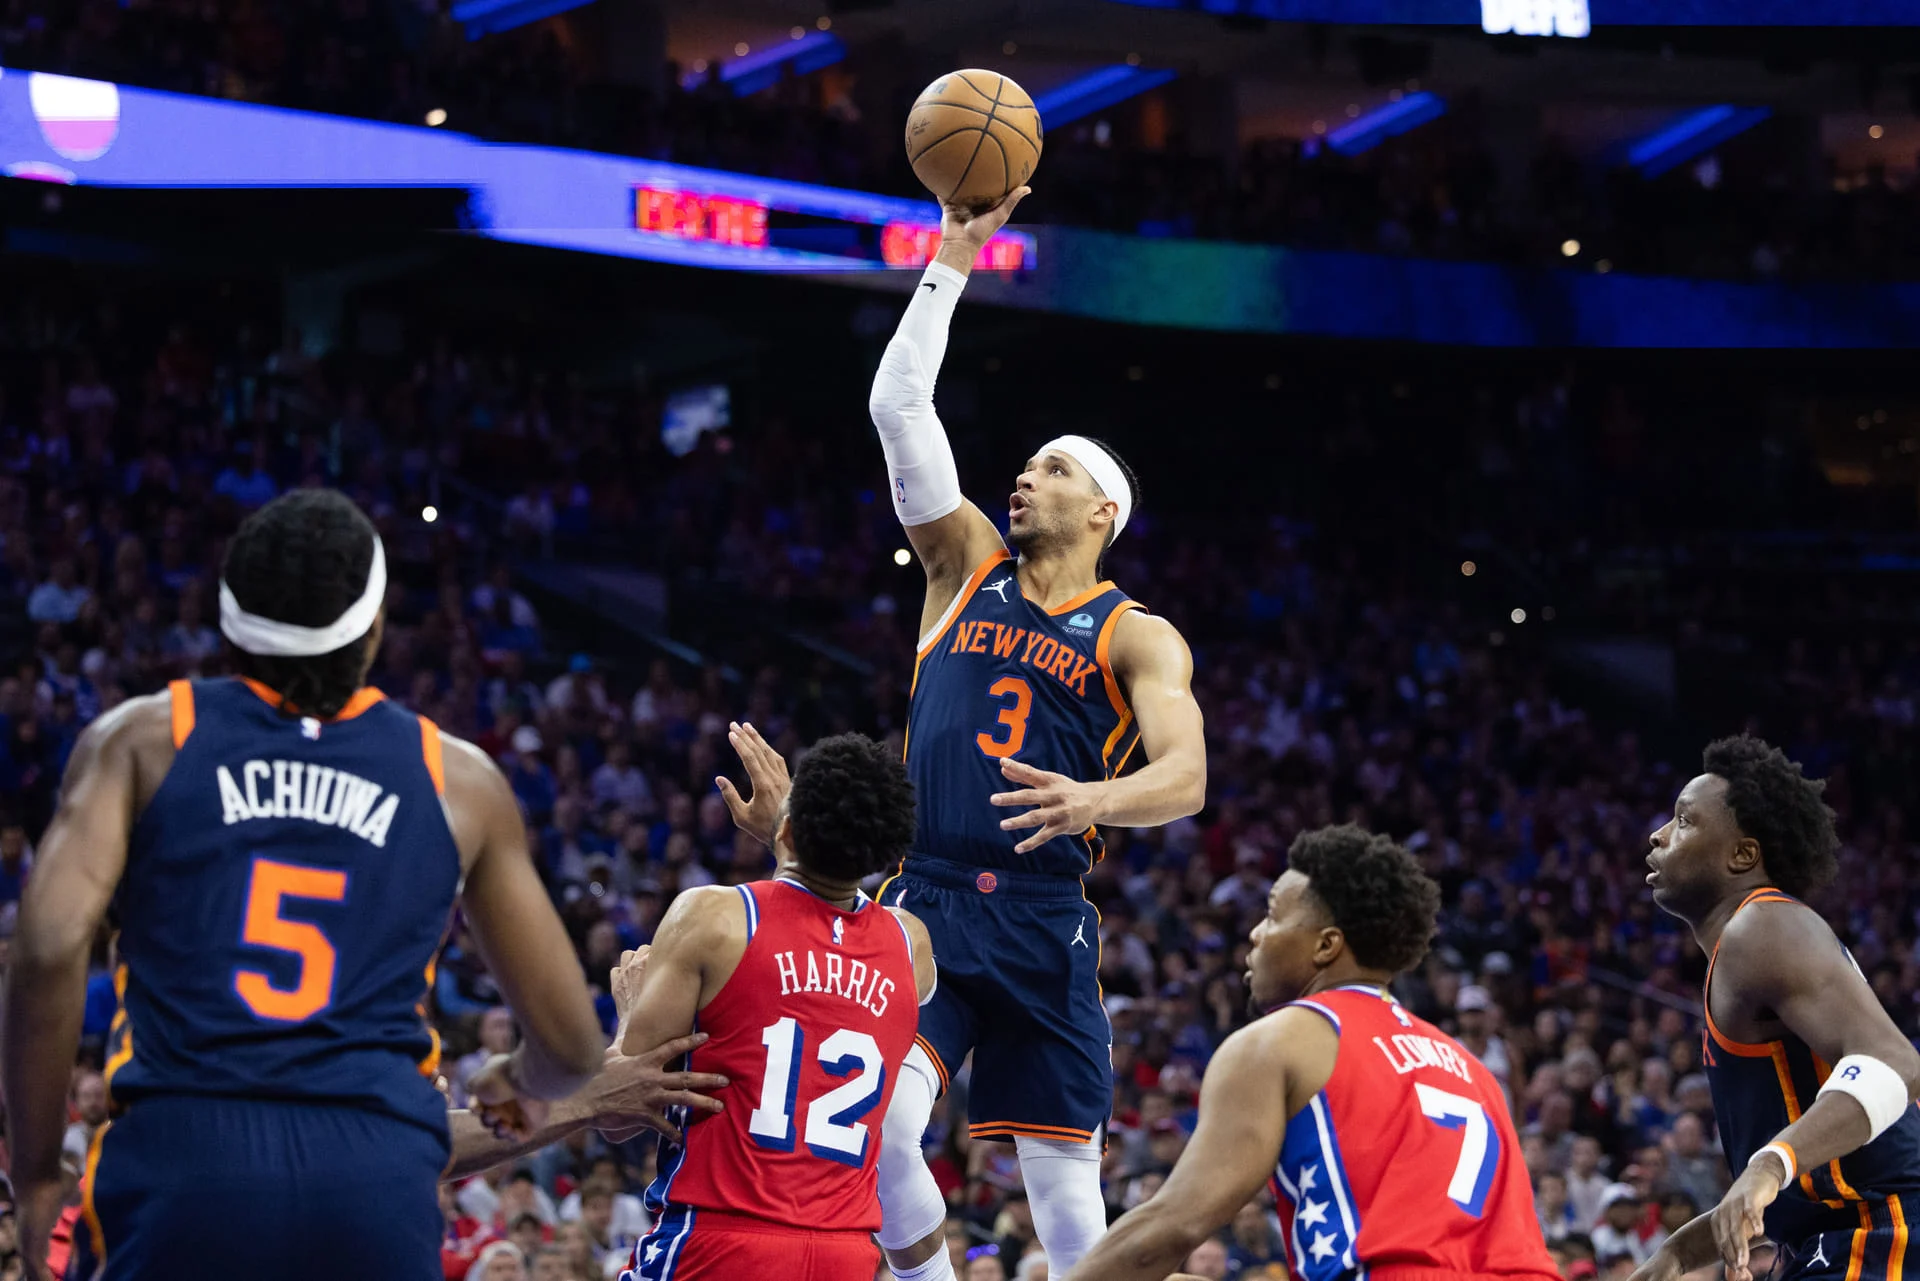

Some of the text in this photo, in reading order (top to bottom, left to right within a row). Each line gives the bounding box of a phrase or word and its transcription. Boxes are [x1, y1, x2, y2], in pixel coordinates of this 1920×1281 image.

[951, 621, 1097, 697] NEW YORK
[1062, 626, 1092, 637] sphere
[974, 673, 1035, 760] 3
[216, 759, 400, 848] ACHIUWA
[233, 856, 348, 1022] 5
[774, 950, 896, 1018] HARRIS
[748, 1016, 886, 1169] 12
[1372, 1034, 1473, 1084] LOWRY
[1414, 1081, 1500, 1219] 7
